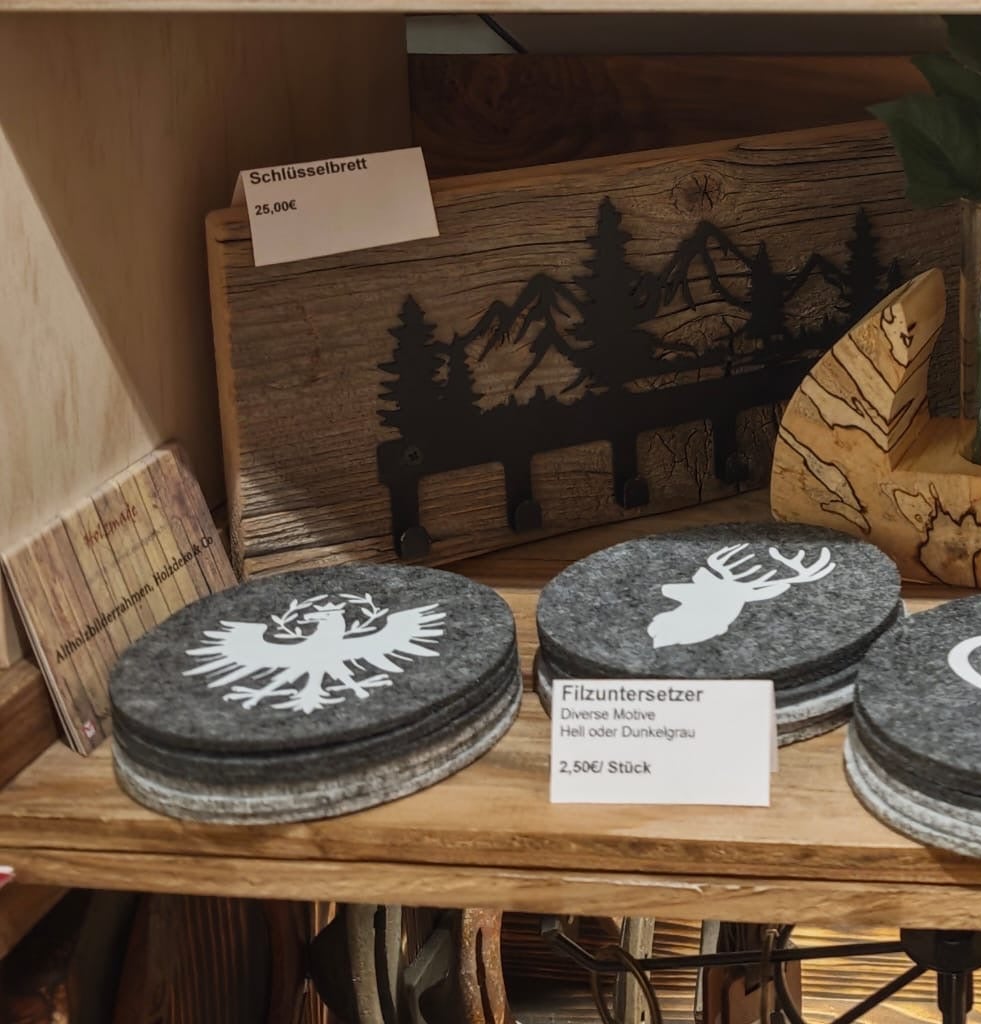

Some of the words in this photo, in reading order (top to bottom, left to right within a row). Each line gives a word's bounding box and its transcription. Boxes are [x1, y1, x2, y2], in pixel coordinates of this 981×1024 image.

[250, 158, 368, 185] Schlüsselbrett
[254, 199, 298, 216] 25,00€
[55, 583, 155, 664] Altholzbilderrahmen,
[153, 551, 193, 586] Holzdeko
[561, 685, 704, 703] Filzuntersetzer
[560, 707, 609, 720] Diverse
[613, 707, 656, 720] Motive
[560, 726, 585, 738] Hell
[589, 726, 618, 738] oder
[621, 726, 696, 742] Dunkelgrau
[559, 760, 604, 776] 2,50€/
[607, 760, 652, 774] Stück
